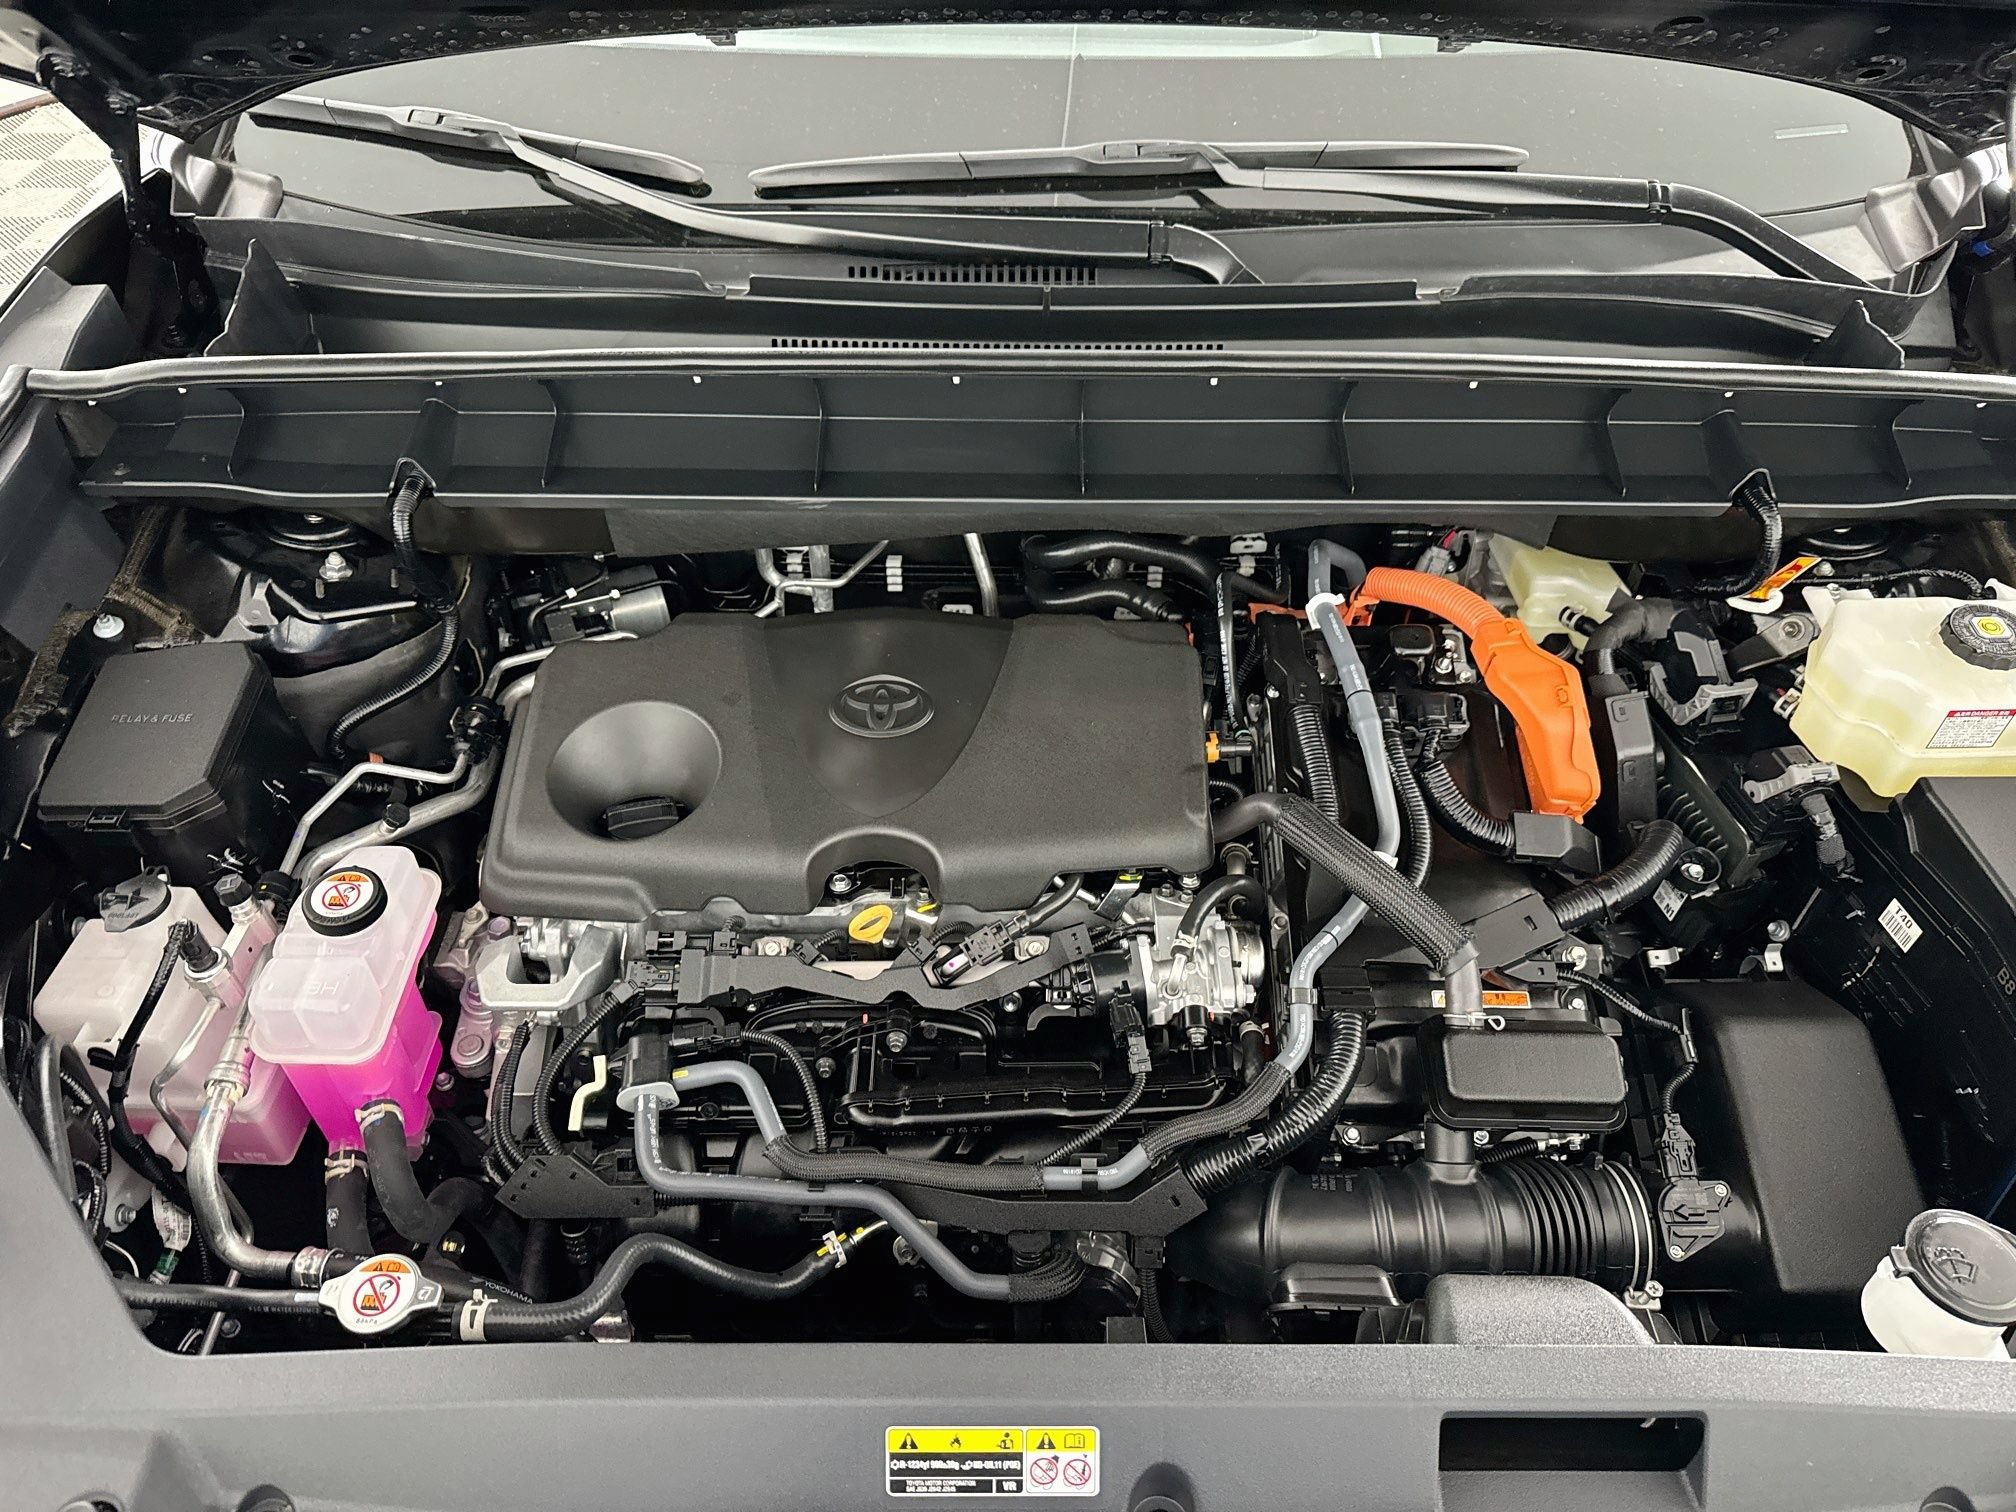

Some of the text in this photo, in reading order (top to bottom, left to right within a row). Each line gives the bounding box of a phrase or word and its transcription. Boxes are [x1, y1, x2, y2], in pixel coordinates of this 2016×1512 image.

[468, 14, 526, 23] TOYOTA
[150, 714, 158, 723] &
[161, 713, 193, 723] FUSE
[1663, 903, 1675, 918] N1
[1996, 966, 2015, 995] B8
[484, 1280, 533, 1305] YOKOHAMA
